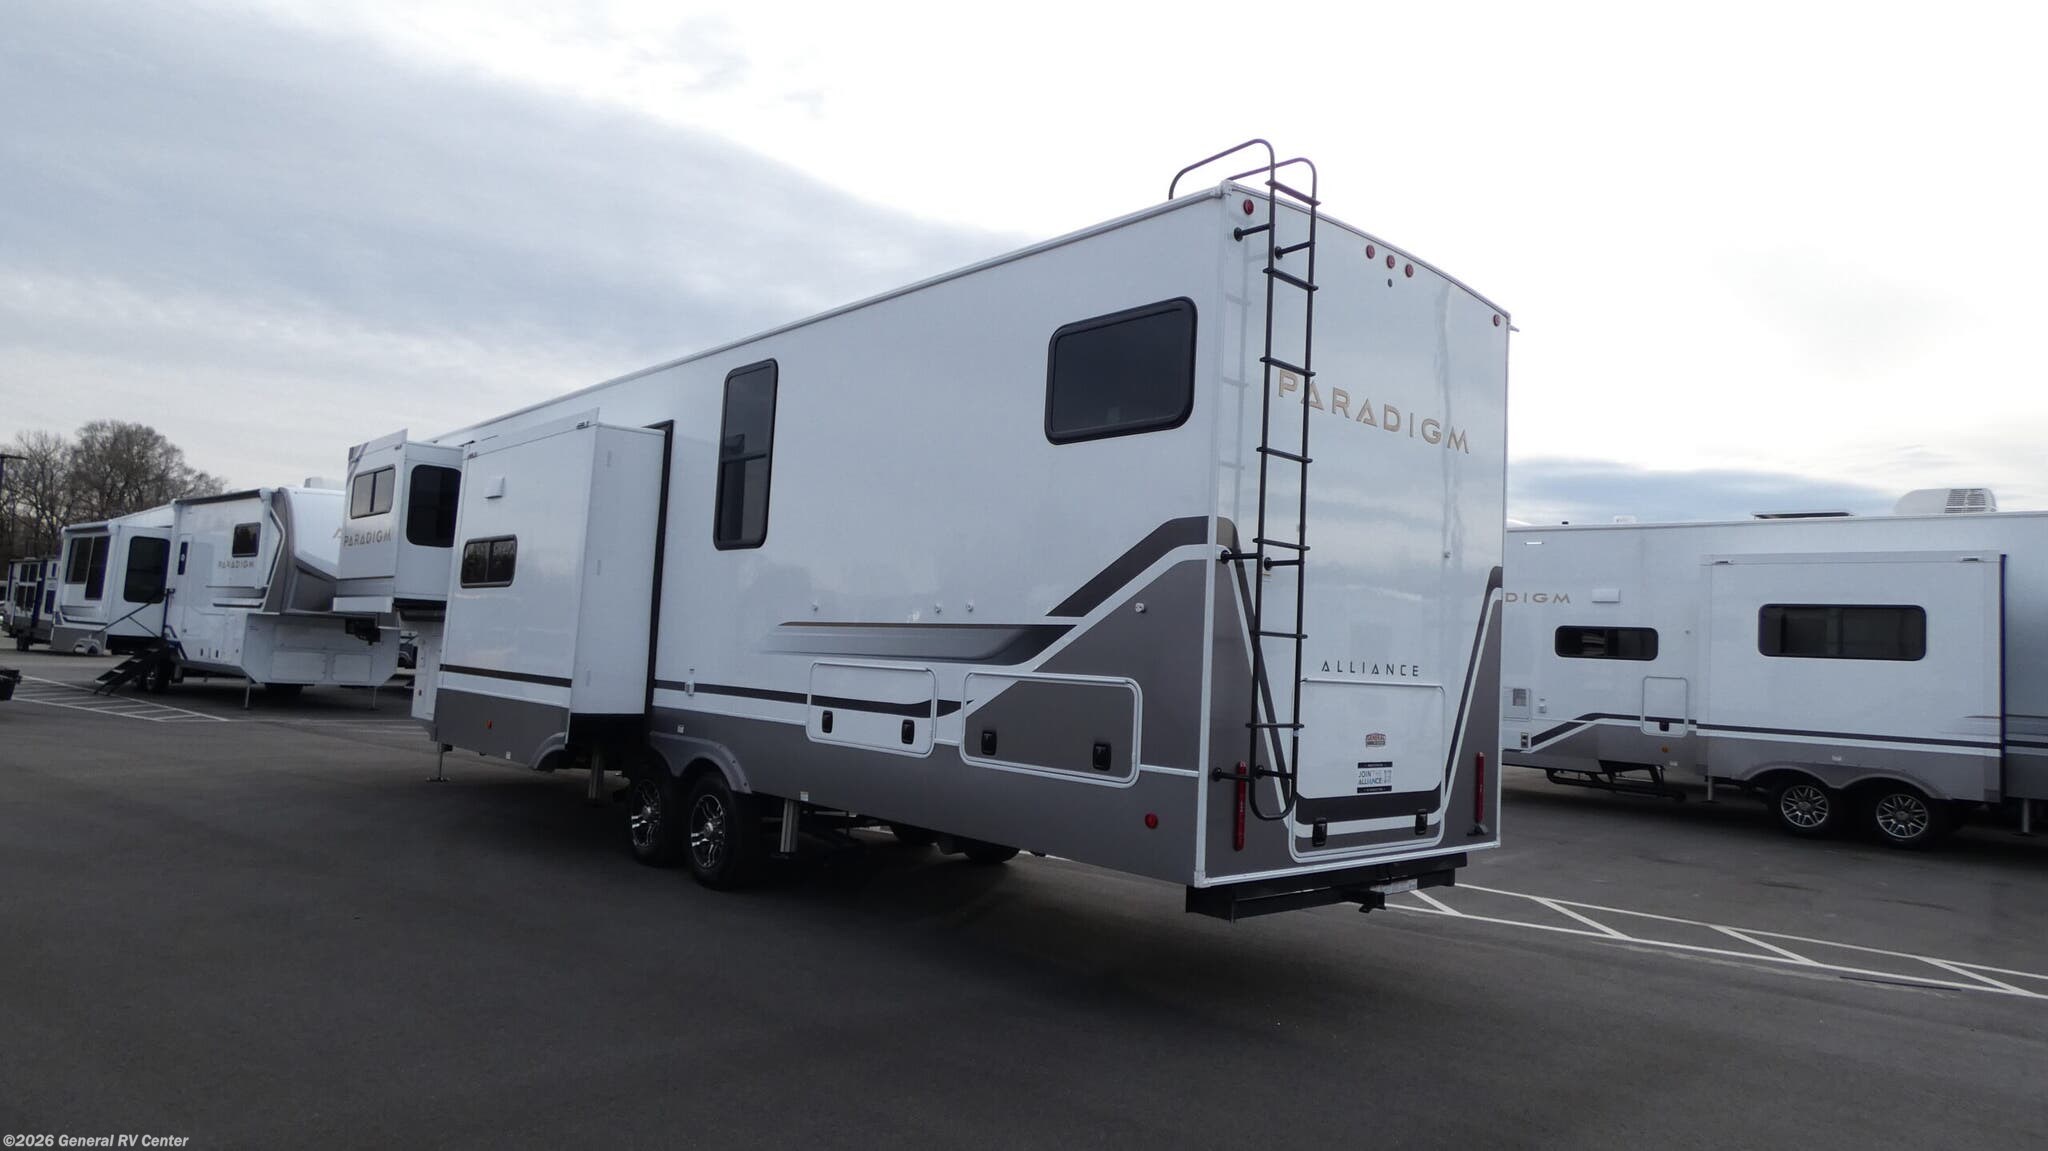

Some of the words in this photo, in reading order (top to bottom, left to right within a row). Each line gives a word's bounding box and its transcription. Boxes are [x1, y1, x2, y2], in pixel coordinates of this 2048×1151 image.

[1278, 369, 1470, 454] PARADIGM
[343, 530, 392, 547] PARADIGM
[1321, 660, 1419, 677] ALLIANCE
[1358, 770, 1371, 778] JOIN
[1358, 777, 1382, 785] ALLIANCE
